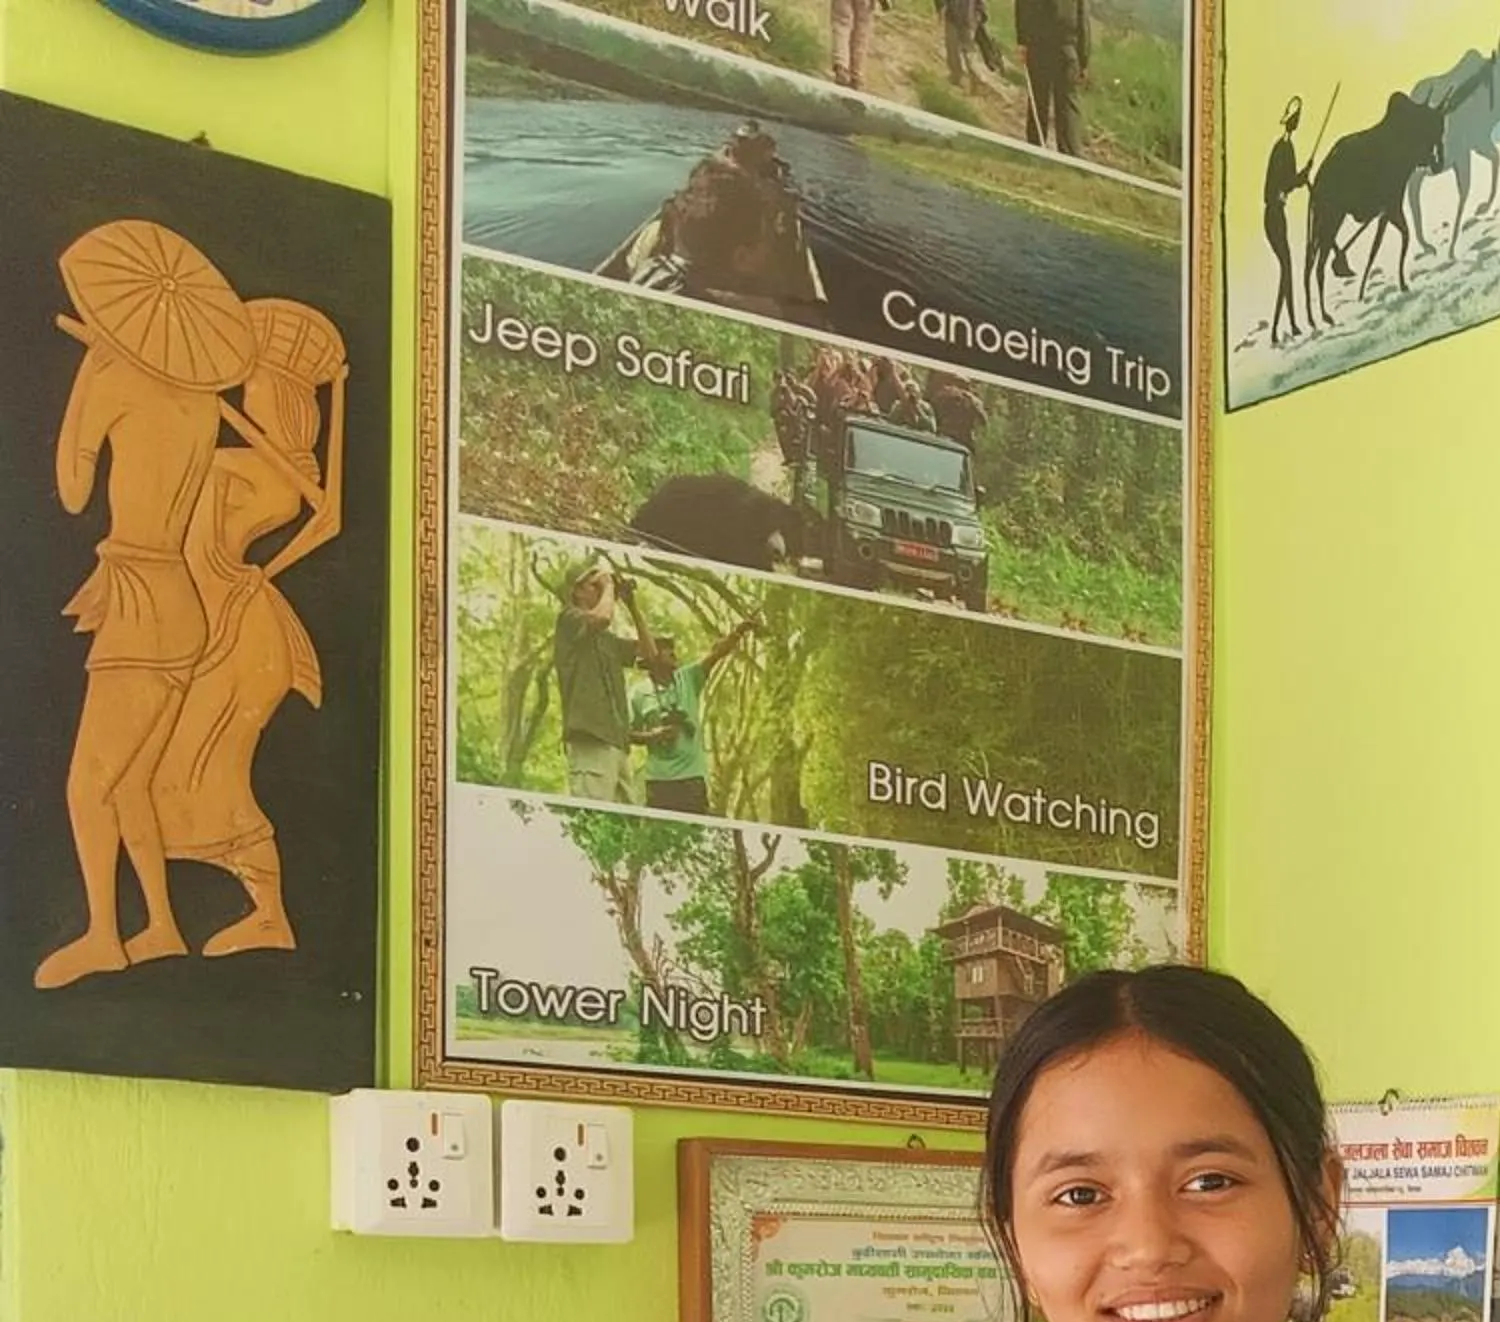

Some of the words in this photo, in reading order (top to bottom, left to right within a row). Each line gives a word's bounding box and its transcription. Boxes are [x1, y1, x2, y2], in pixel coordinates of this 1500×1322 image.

[468, 302, 598, 372] Jeep
[615, 337, 752, 403] Safari
[881, 289, 1093, 383] Canoeing
[1105, 346, 1171, 401] Trip
[868, 761, 947, 810] Bird
[965, 776, 1161, 848] Watching
[470, 968, 627, 1023] Tower
[641, 998, 767, 1041] Night
[1352, 1166, 1391, 1180] JALJALA
[1393, 1166, 1419, 1180] SEWA
[1421, 1166, 1451, 1179] SAMAJ
